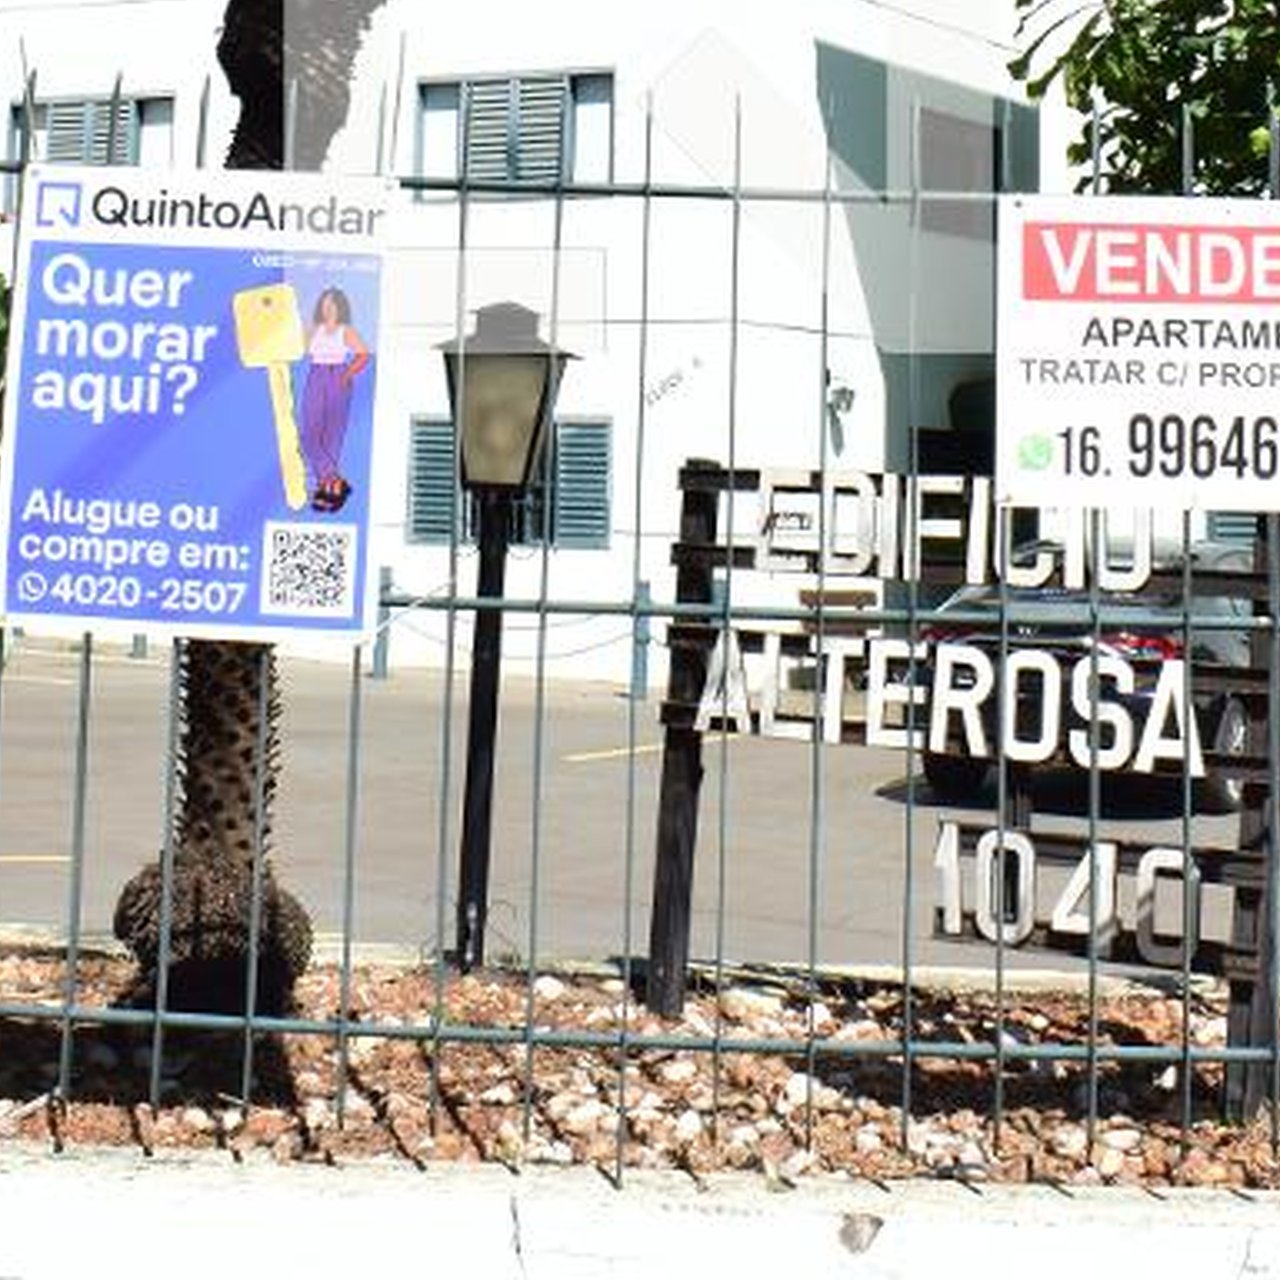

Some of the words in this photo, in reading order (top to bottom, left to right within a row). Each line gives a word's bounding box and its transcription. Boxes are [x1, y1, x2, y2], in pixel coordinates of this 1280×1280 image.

[91, 185, 383, 237] QuintoAndar
[42, 253, 193, 308] Quer
[35, 317, 218, 363] morar
[31, 364, 199, 423] aqui?
[1019, 358, 1145, 387] TRATAR
[1157, 361, 1189, 387] C/
[1057, 426, 1112, 478] 16.
[22, 488, 161, 534] Alugue
[169, 503, 218, 531] ou
[18, 531, 168, 573] compre
[178, 542, 251, 572] em:
[51, 573, 248, 614] 4020-2507
[693, 623, 1207, 777] ALTEROSA
[931, 820, 1202, 966] 1040
